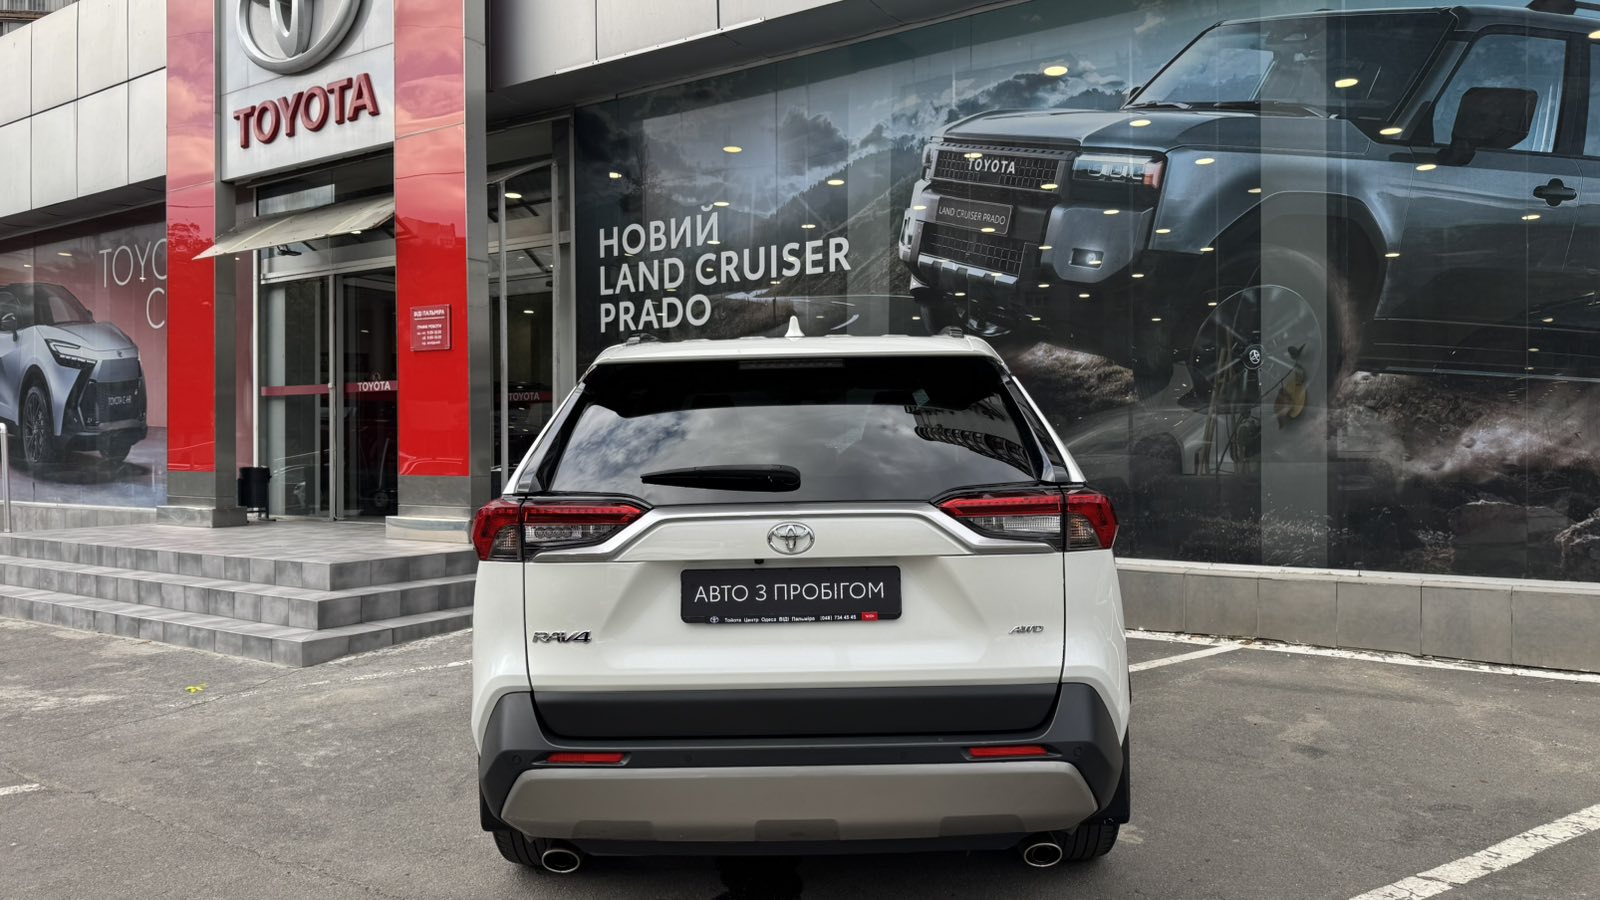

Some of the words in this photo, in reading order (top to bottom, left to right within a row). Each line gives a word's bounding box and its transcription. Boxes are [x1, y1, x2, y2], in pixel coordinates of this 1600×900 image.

[233, 73, 380, 149] TOYOTA
[968, 158, 1015, 174] TOYOTA
[939, 206, 955, 217] LAND
[956, 209, 981, 221] CRUISER
[982, 213, 1006, 225] PRADO
[600, 204, 718, 258] НОВИЙ
[600, 257, 685, 296] LAND
[695, 237, 851, 286] CRUISER
[600, 294, 712, 333] PRADO
[357, 381, 391, 391] TOYOTA
[508, 392, 540, 401] TOYOTA
[694, 584, 749, 602] АВТО
[774, 581, 885, 600] ПРОБІГОМ
[532, 630, 592, 644] RAV4
[1008, 624, 1044, 635] AWD
